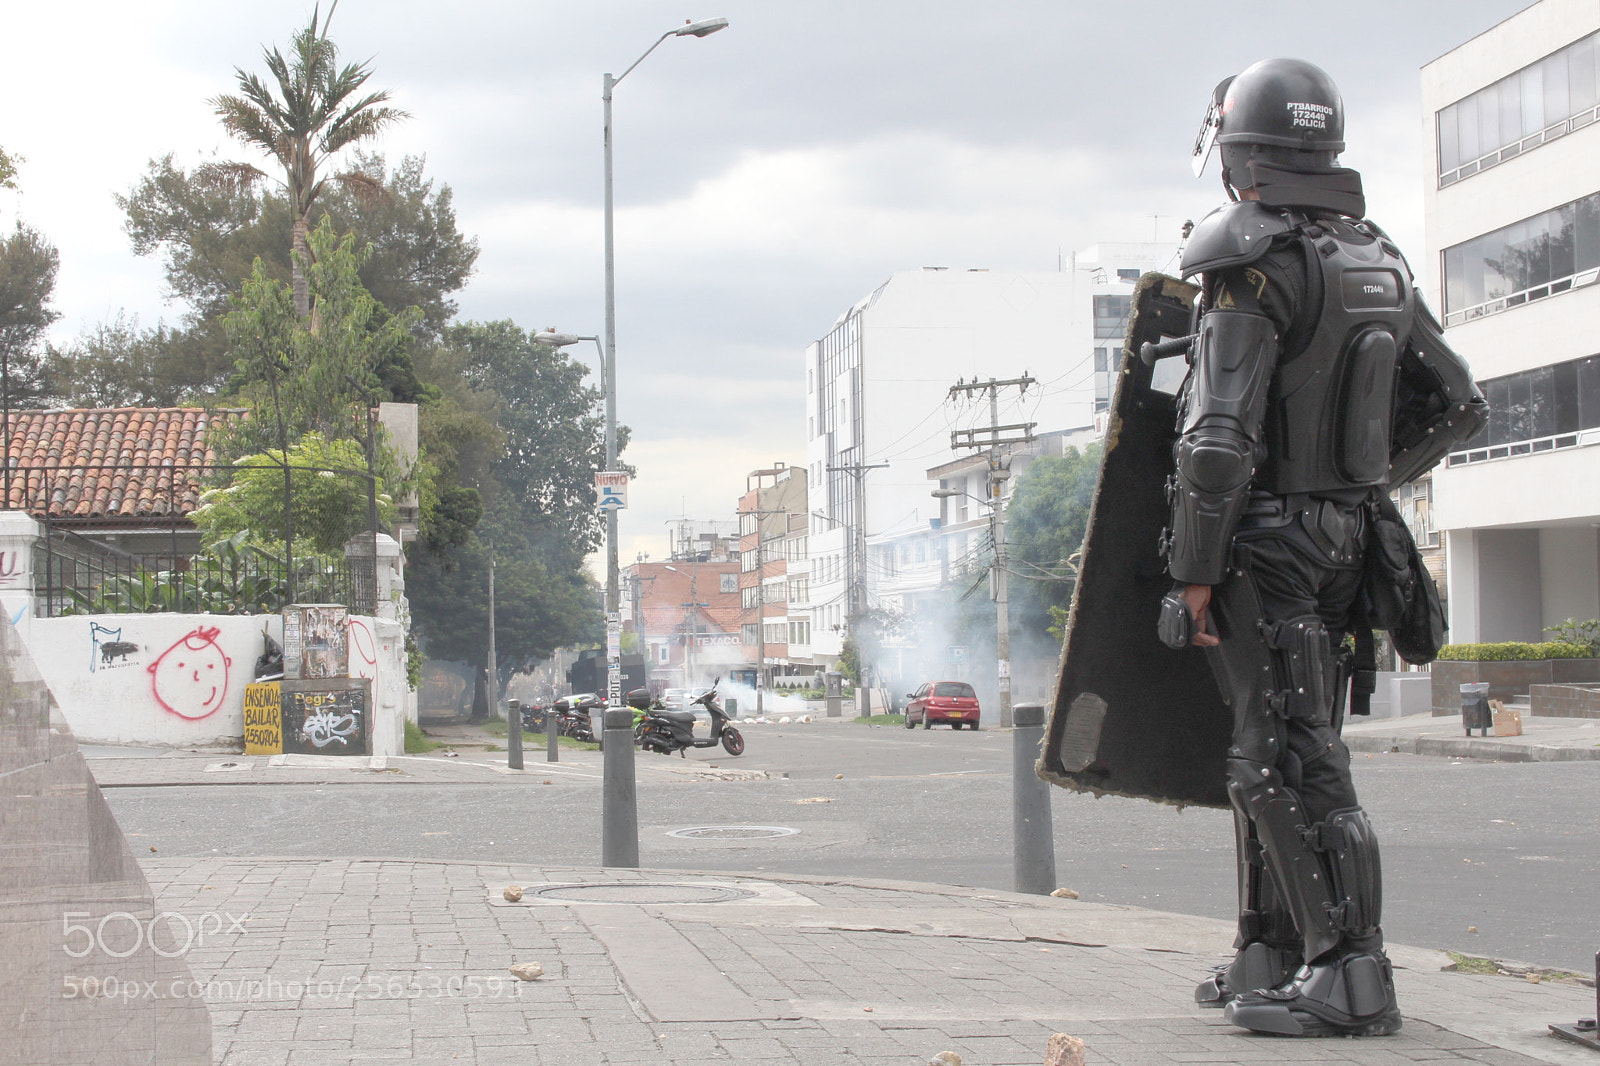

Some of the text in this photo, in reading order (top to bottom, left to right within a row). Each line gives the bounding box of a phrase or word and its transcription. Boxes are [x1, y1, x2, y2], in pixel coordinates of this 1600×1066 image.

[1292, 111, 1326, 120] 172449
[1293, 119, 1326, 129] POLICIA
[595, 474, 628, 486] NUEVO
[697, 637, 740, 646] TEXACO
[245, 708, 280, 729] BAILAR
[245, 728, 280, 748] 2550704
